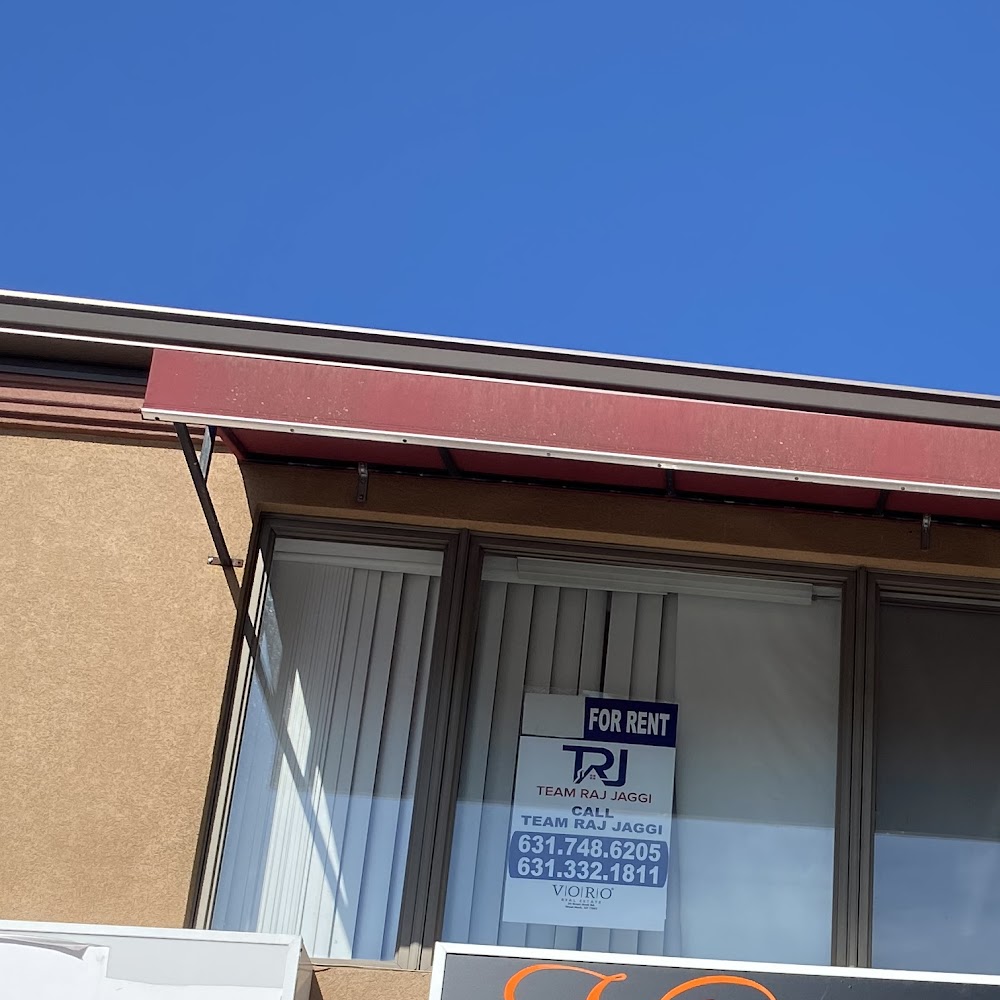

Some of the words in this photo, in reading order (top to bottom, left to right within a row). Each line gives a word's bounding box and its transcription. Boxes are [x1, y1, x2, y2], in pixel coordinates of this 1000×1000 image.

[588, 707, 622, 733] FOR
[625, 710, 670, 737] RENT
[536, 785, 577, 798] TEAM
[579, 789, 608, 801] RAJ
[610, 791, 652, 804] JAGGI
[571, 805, 615, 819] CALL
[521, 815, 570, 829] TEAM
[573, 818, 607, 832] RAJ
[611, 821, 663, 836] JAGGI
[517, 834, 662, 862] 631.748.6205
[517, 856, 660, 885] 631.332.1811
